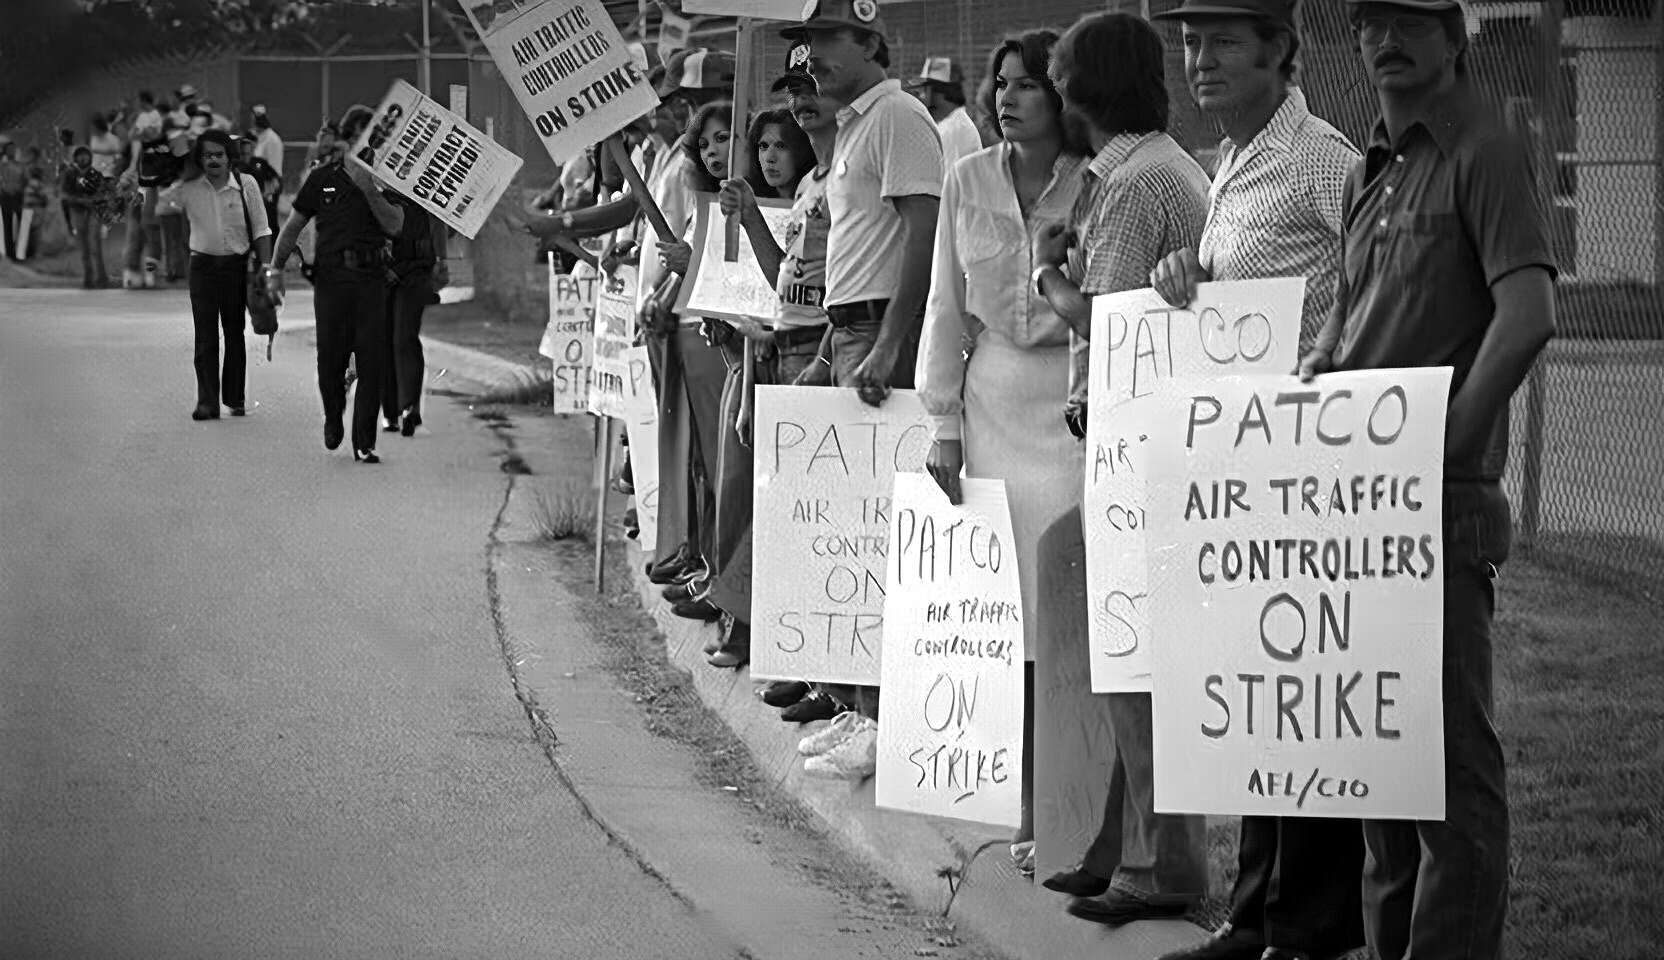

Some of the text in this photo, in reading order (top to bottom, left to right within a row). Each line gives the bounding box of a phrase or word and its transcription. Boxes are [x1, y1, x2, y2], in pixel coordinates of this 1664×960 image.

[511, 37, 540, 67] AIR
[534, 4, 592, 53] TRAFFIC
[521, 30, 611, 97] CONTROLLERS
[535, 61, 643, 138] ON STRIKE
[412, 125, 469, 200] CONTRACT
[1106, 306, 1271, 398] PATCO
[1186, 385, 1408, 449] PATCO
[1094, 438, 1135, 485] AIR
[793, 499, 831, 525] AIR
[1184, 474, 1423, 521] AIR TRAFFIC
[898, 508, 1001, 585] PATCO
[1199, 534, 1436, 584] CONTROLLERS
[927, 601, 951, 624] AIR
[1259, 591, 1351, 662] ON
[924, 673, 979, 732] ON
[1201, 671, 1401, 742] STRIKE
[909, 744, 1008, 793] STRIKE
[1248, 768, 1370, 808] AFL/CIO
